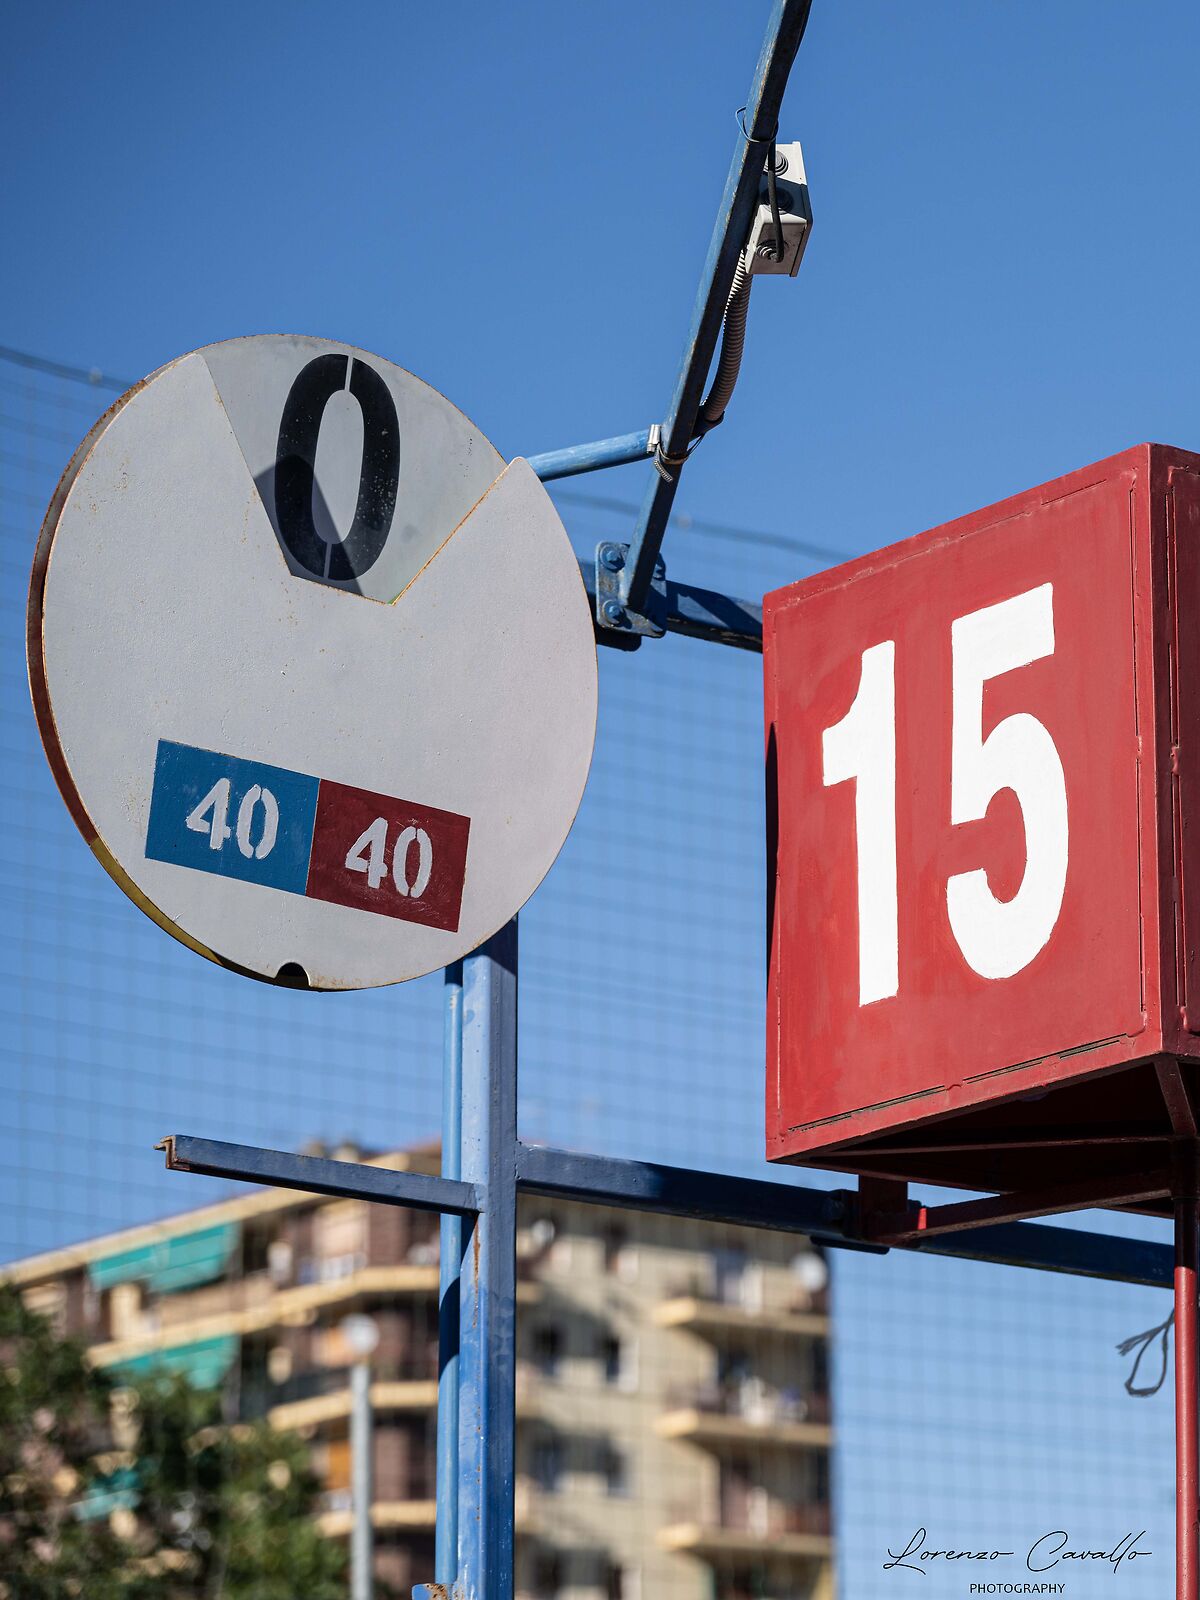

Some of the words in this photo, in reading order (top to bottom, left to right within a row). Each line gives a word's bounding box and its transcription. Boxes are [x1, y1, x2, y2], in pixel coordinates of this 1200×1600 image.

[274, 353, 400, 581] 0
[186, 777, 279, 860] 40
[345, 817, 433, 898] 40
[822, 582, 1069, 1007] 15
